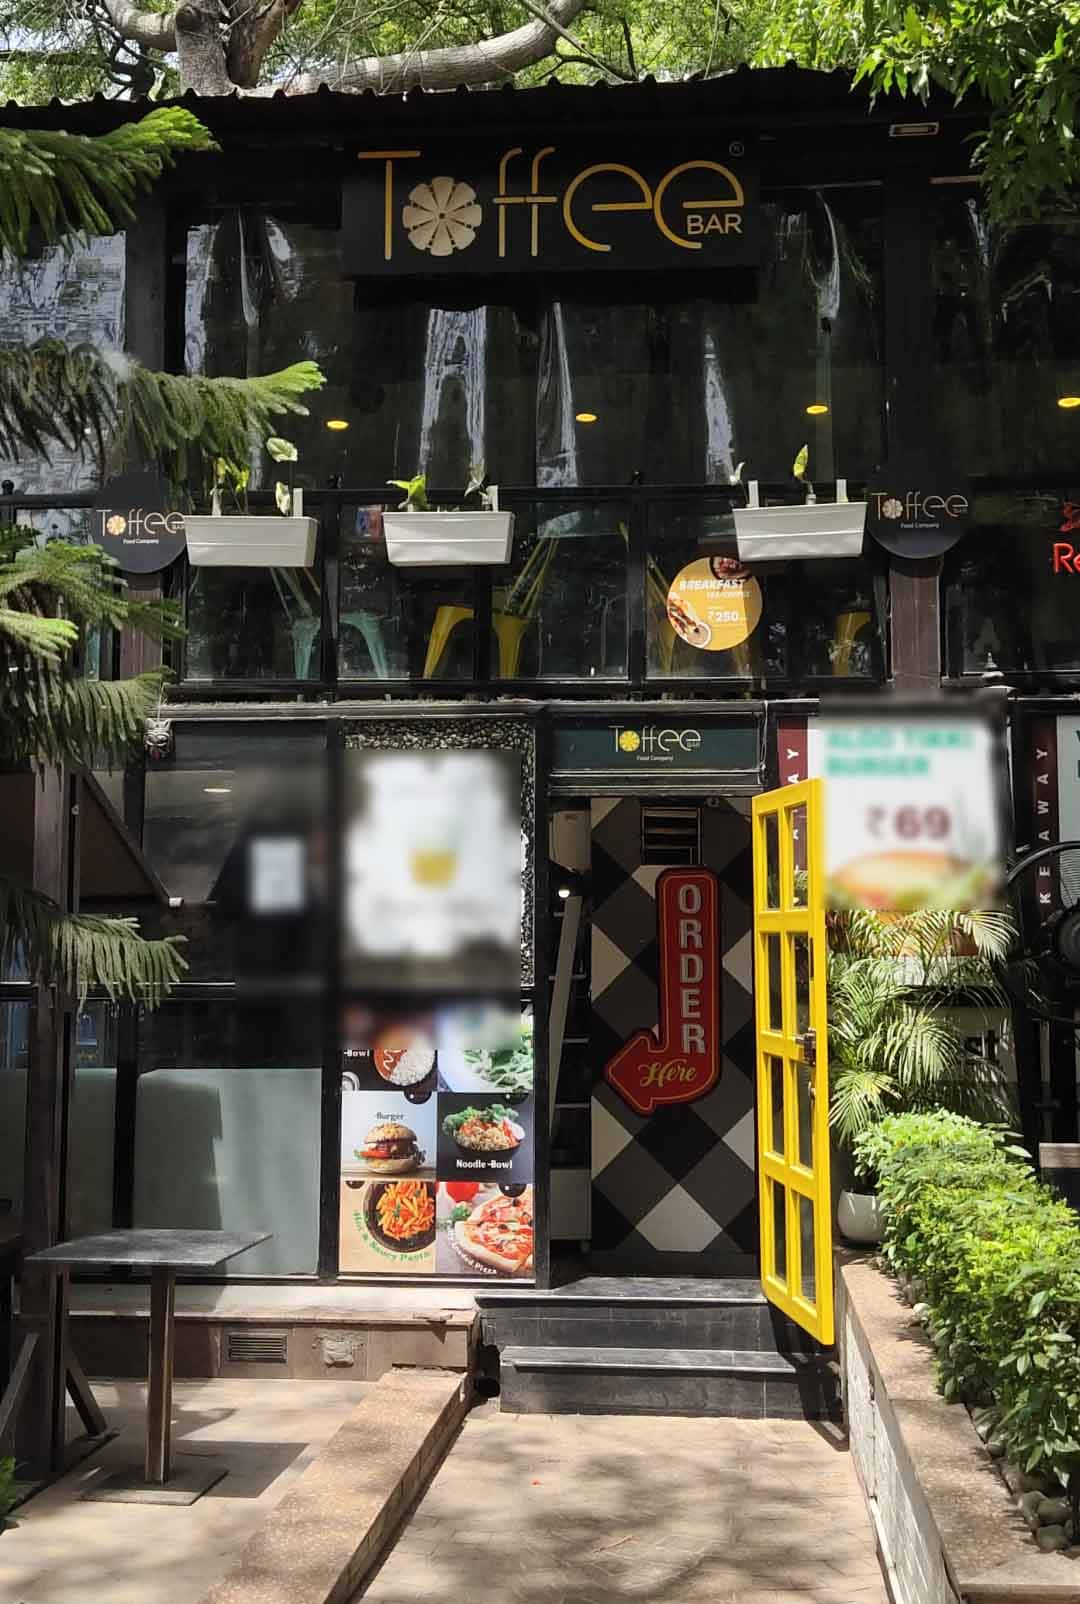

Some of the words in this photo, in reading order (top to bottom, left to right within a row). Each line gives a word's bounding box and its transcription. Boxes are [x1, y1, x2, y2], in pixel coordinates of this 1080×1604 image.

[358, 147, 744, 259] Toffee
[686, 213, 742, 234] BAR
[870, 491, 969, 520] Toffee
[96, 507, 185, 536] Toffee
[608, 725, 701, 752] Toffee
[1036, 748, 1051, 904] KEAWAY
[679, 884, 706, 1054] ORDER
[638, 1059, 697, 1087] Here
